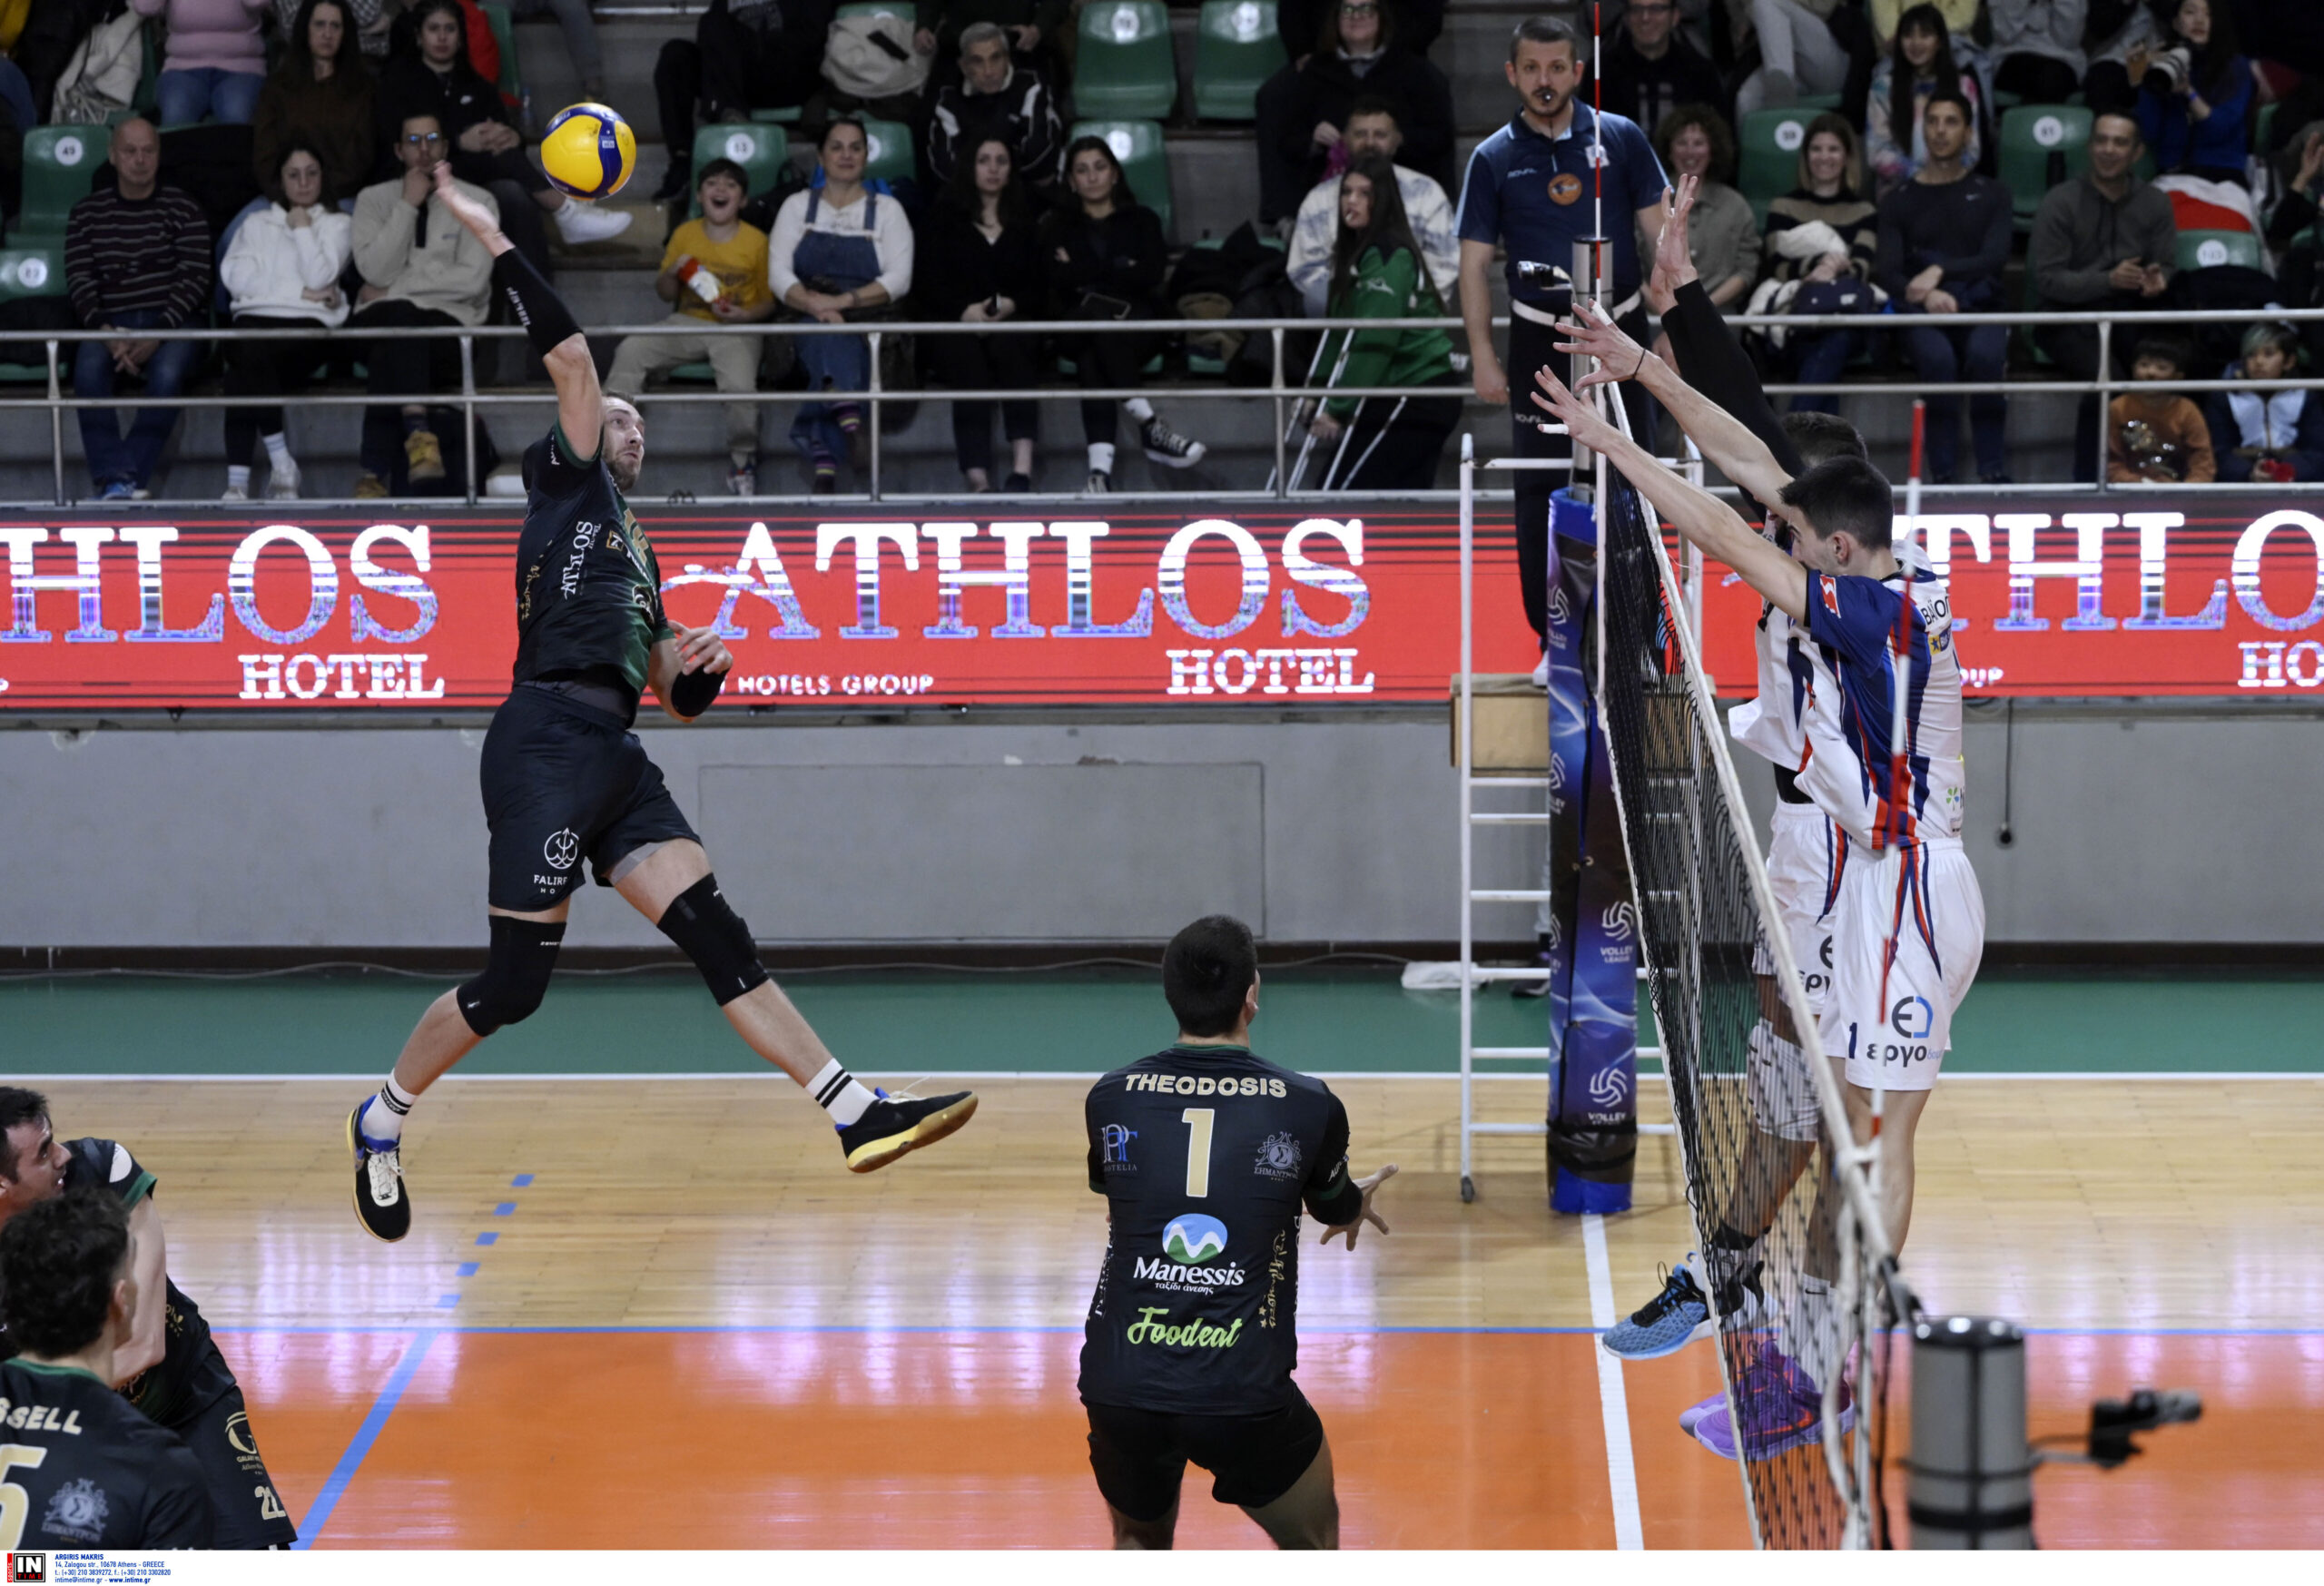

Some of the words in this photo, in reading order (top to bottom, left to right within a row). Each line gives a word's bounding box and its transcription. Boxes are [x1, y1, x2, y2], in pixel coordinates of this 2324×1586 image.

[662, 519, 1370, 639] ATHLOS
[1893, 509, 2324, 631] THLO
[238, 653, 445, 699] HOTEL
[738, 675, 831, 694] HOTELS
[842, 675, 933, 694] GROUP
[1166, 647, 1374, 694] HOTEL
[1600, 945, 1633, 956] VOLLEY
[1126, 1074, 1287, 1098] THEODOSIS
[1588, 1112, 1626, 1122] VOLLEY
[1181, 1108, 1216, 1197] 1
[1133, 1256, 1246, 1286] Manessis
[1155, 1281, 1181, 1291] ταξίδι
[1183, 1283, 1214, 1295] άνεσης
[1127, 1306, 1243, 1348] Foodeat
